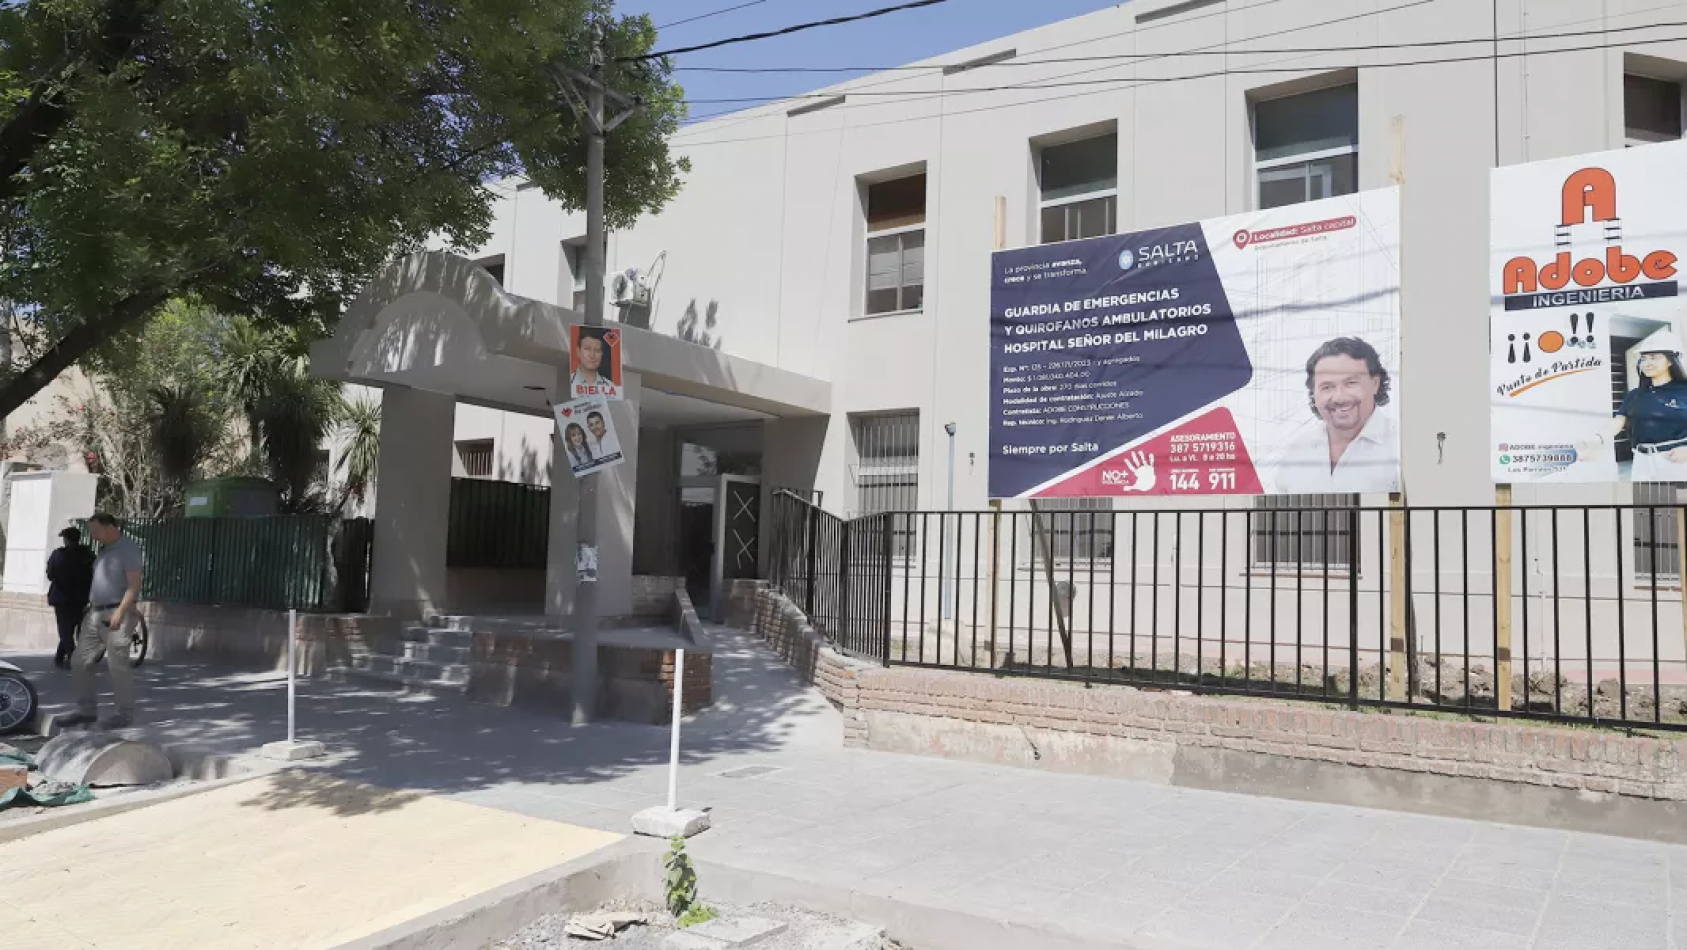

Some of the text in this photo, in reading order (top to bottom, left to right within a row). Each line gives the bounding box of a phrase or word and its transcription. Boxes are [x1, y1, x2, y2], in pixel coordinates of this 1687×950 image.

[1254, 218, 1354, 241] Localidad: Salta capital
[1138, 239, 1198, 261] SALTA
[1004, 266, 1013, 275] La
[1015, 261, 1050, 273] provincia
[1503, 246, 1678, 294] Adobe
[1004, 275, 1025, 284] crece
[1026, 275, 1031, 283] y
[1004, 287, 1180, 318] GUARDIA DE EMERGENCIAS
[1533, 285, 1645, 308] INGENIERIA
[1004, 303, 1212, 336] Y QUIROFANOS AMBULATORIOS
[1004, 323, 1208, 354] HOSPITAL SEÑOR DEL MILAGRO
[1102, 355, 1141, 366] agregados
[1496, 356, 1602, 396] Punto de Partida
[1003, 396, 1037, 404] Modalidad
[1039, 395, 1047, 403] de
[1170, 432, 1237, 443] ASESORAMIENTO
[1002, 441, 1099, 456] Siempre por Salta
[1170, 441, 1236, 454] 387 5719316
[1509, 443, 1536, 451] ADOBE
[1170, 472, 1236, 490] 144 911
